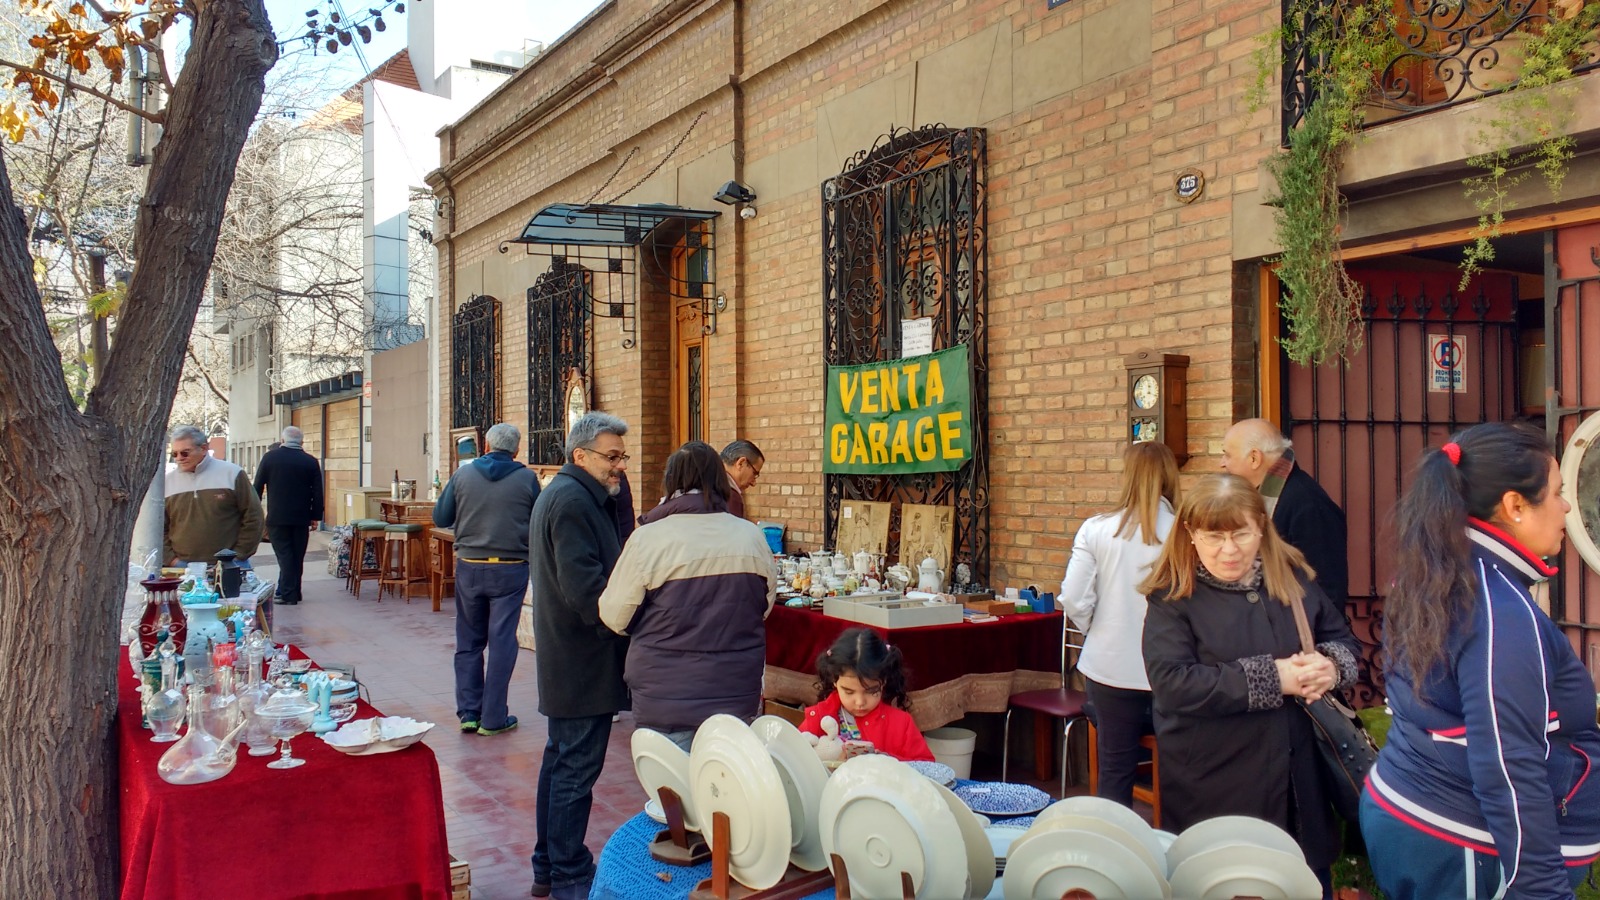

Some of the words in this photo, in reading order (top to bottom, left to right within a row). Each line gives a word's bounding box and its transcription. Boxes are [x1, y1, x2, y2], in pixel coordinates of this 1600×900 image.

[1180, 176, 1195, 189] 375
[839, 359, 945, 414] VENTA
[830, 411, 964, 464] GARAGE
